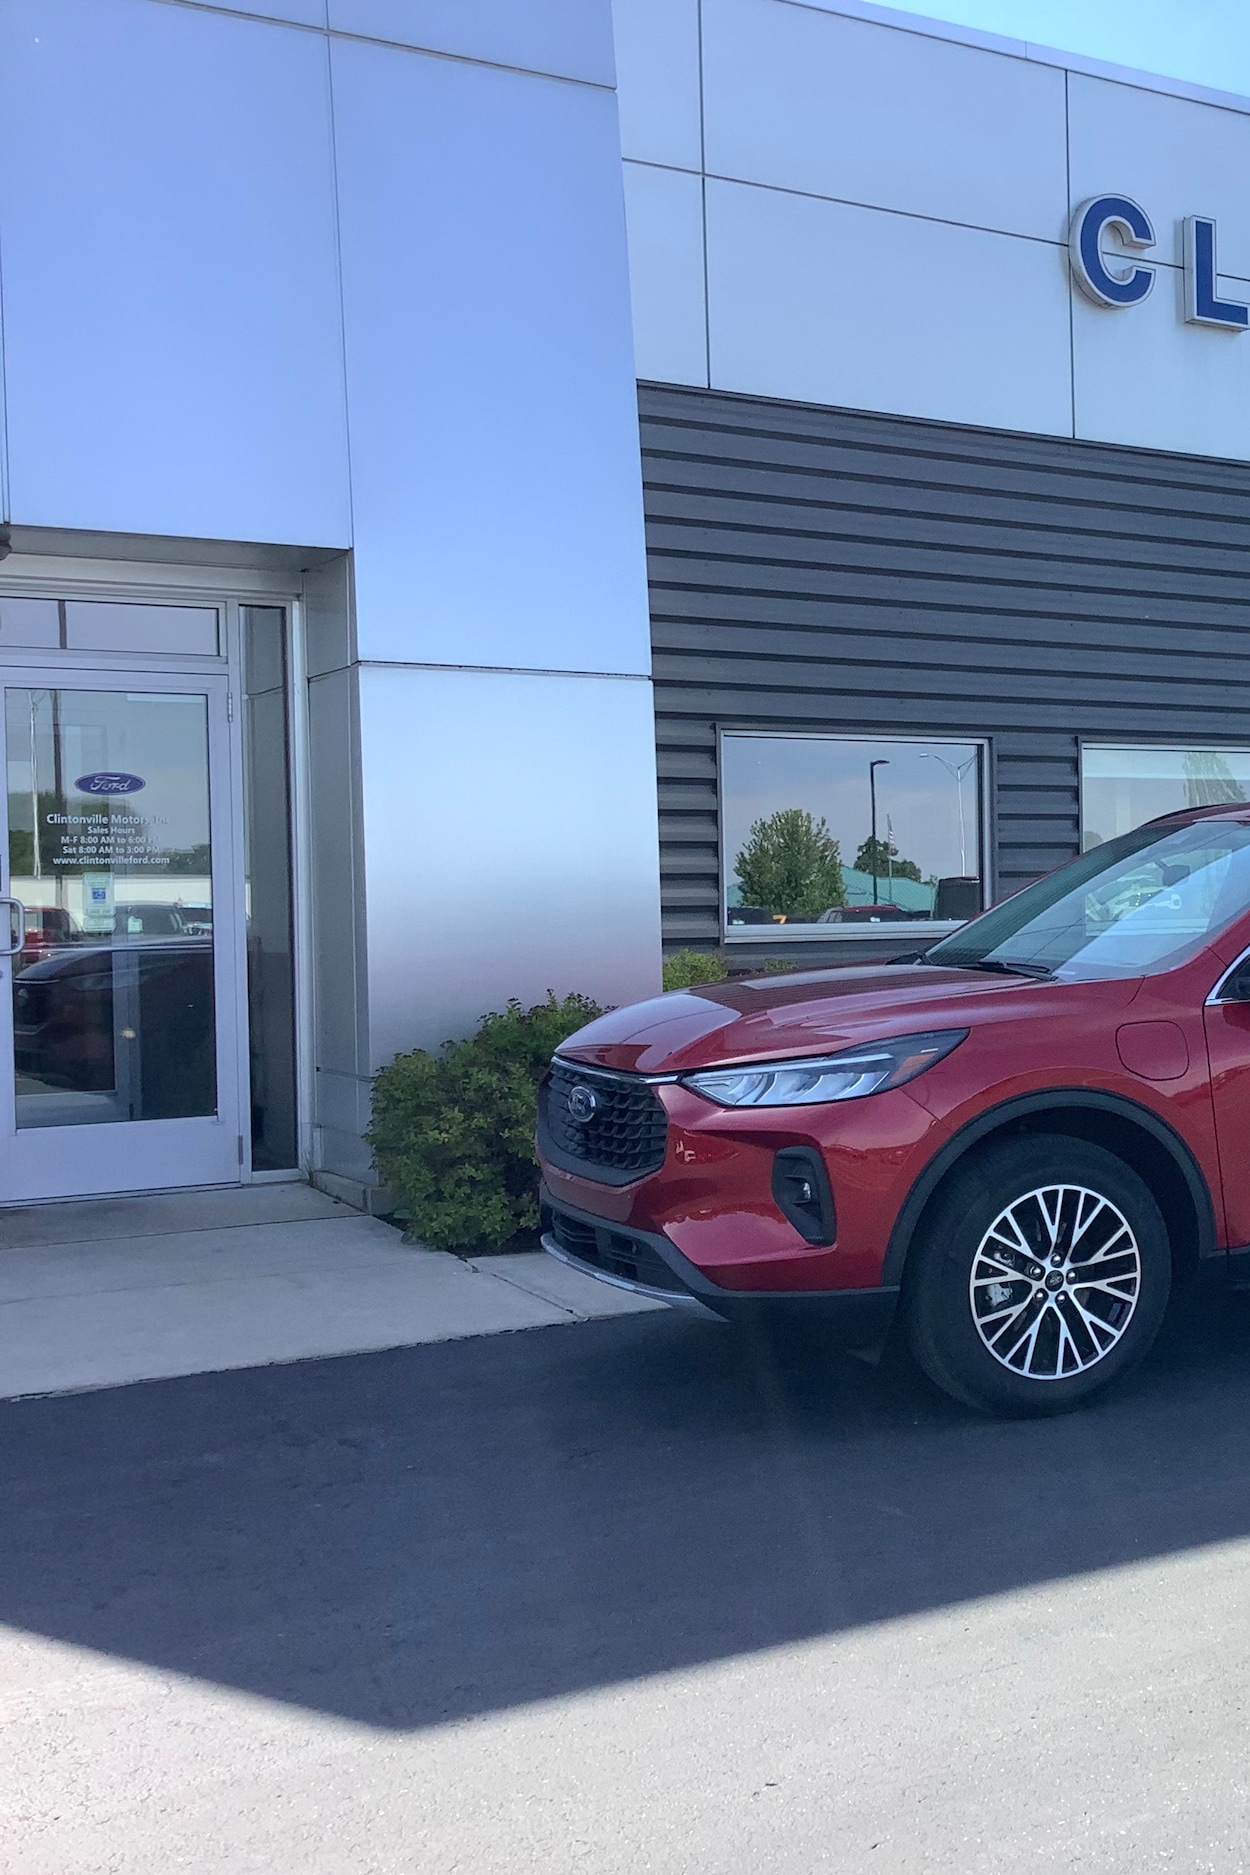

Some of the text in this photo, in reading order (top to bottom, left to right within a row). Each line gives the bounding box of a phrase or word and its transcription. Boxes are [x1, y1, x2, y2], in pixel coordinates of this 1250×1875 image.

[90, 775, 131, 790] Ford
[46, 814, 108, 824] Clintonville
[87, 826, 108, 834] Sales
[60, 835, 78, 844] M-F
[80, 836, 98, 844] 8:00
[100, 836, 115, 844] AM
[128, 836, 146, 844] 6:00
[62, 846, 76, 854] Sat
[78, 846, 97, 854] 8:00
[98, 846, 113, 854] AM
[116, 846, 125, 854] to
[126, 846, 144, 854] 3:00
[52, 855, 170, 865] www.clintonvilleford.com
